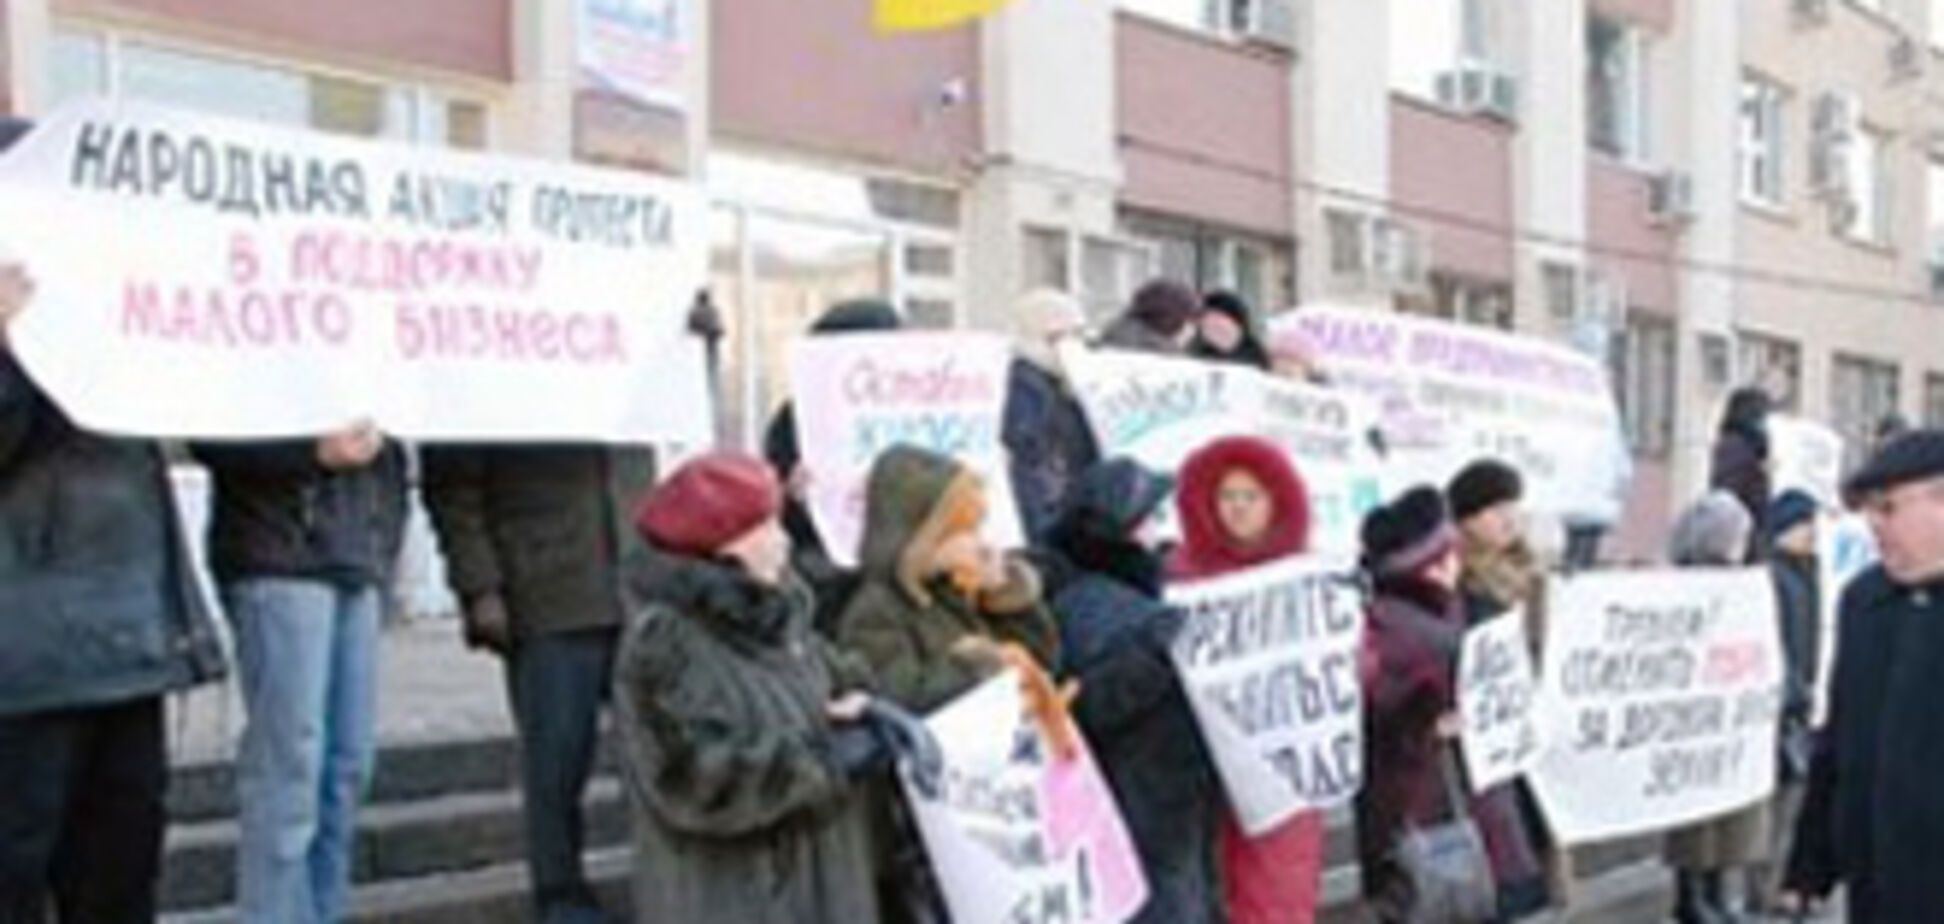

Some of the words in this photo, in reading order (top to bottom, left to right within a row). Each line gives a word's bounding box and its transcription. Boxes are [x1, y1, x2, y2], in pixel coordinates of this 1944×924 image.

[71, 122, 371, 220] НАРОДНАЯ
[290, 233, 543, 292] ПОДДЕРЖКУ
[121, 282, 352, 347] МАЛОГО
[396, 304, 630, 364] БИЗНЕСА
